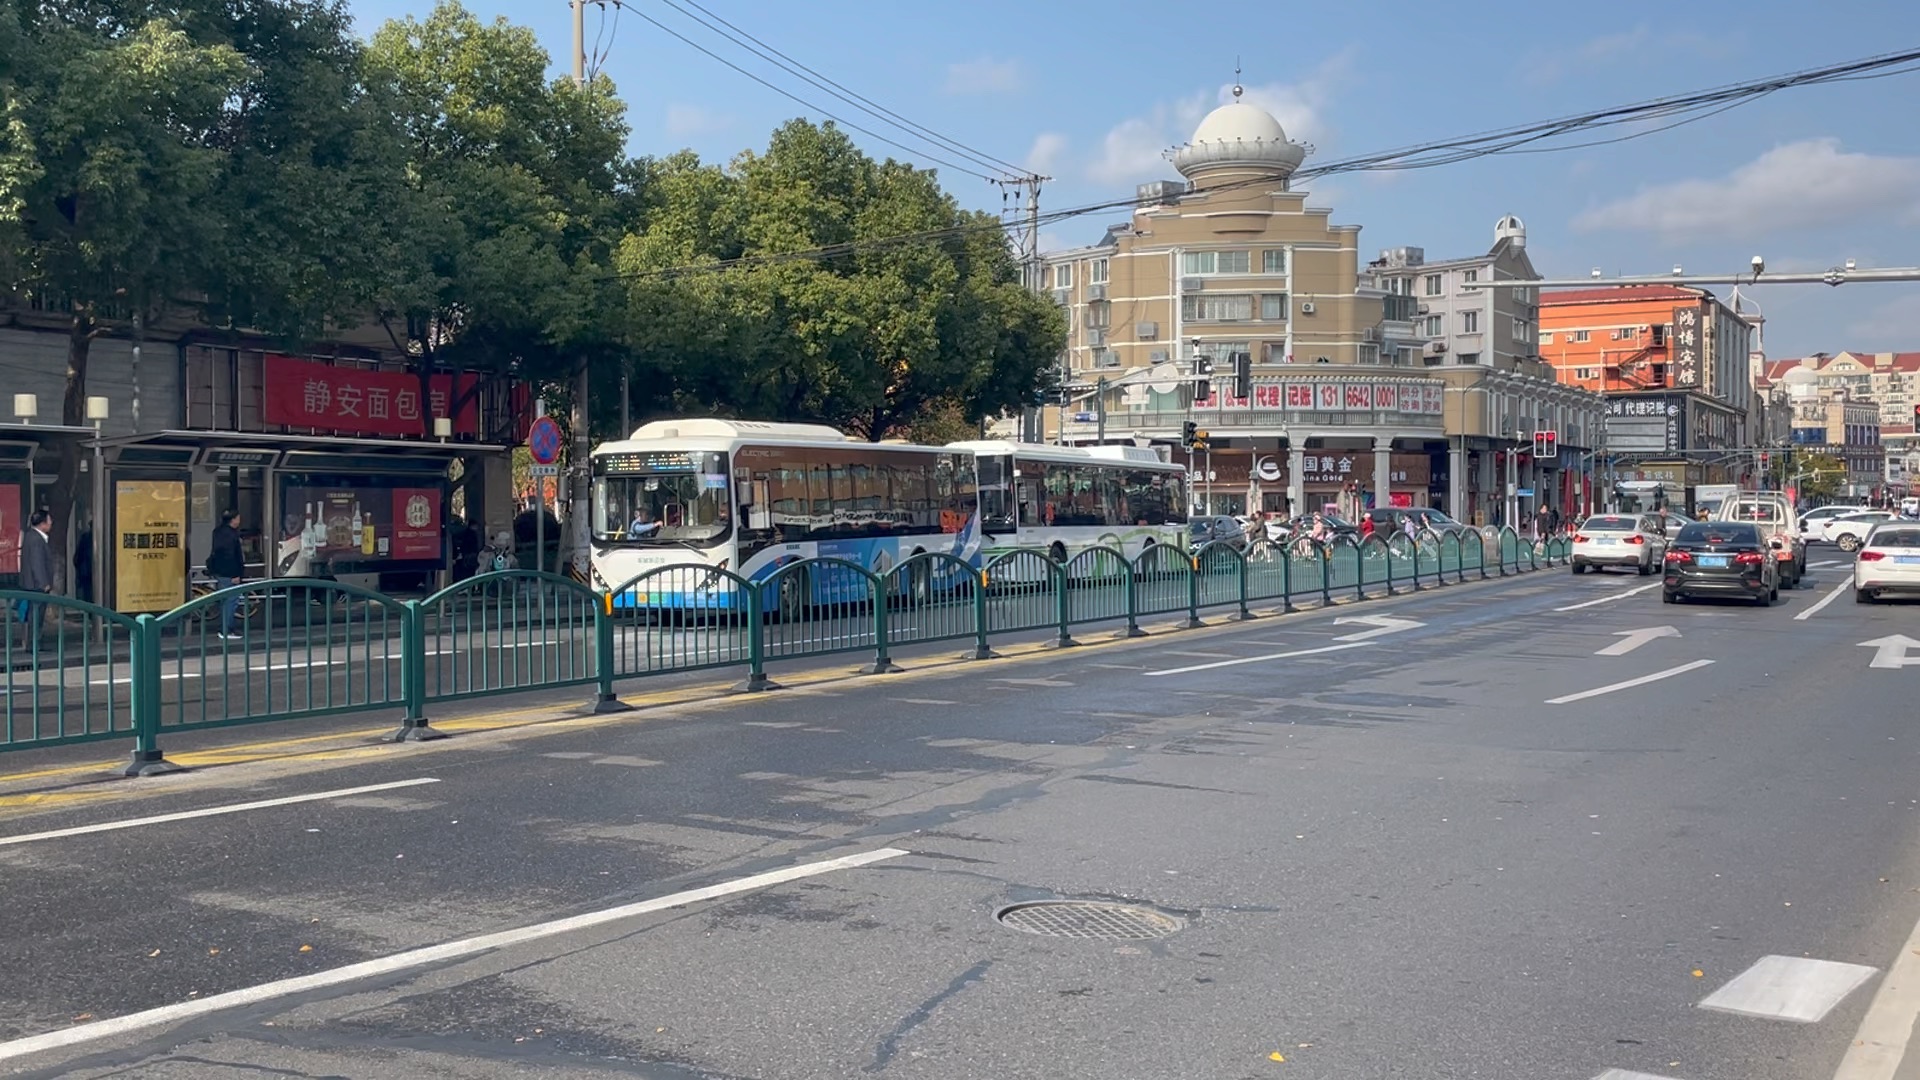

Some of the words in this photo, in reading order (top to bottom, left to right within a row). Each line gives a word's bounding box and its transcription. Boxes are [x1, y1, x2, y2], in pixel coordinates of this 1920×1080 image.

[1678, 310, 1697, 384] 鸿博宾馆
[1256, 385, 1280, 407] 代理
[1288, 385, 1311, 407] 记账
[1321, 385, 1339, 407] 131
[1347, 386, 1369, 408] 6642
[1376, 386, 1396, 407] 0001
[1322, 474, 1343, 482] Gold
